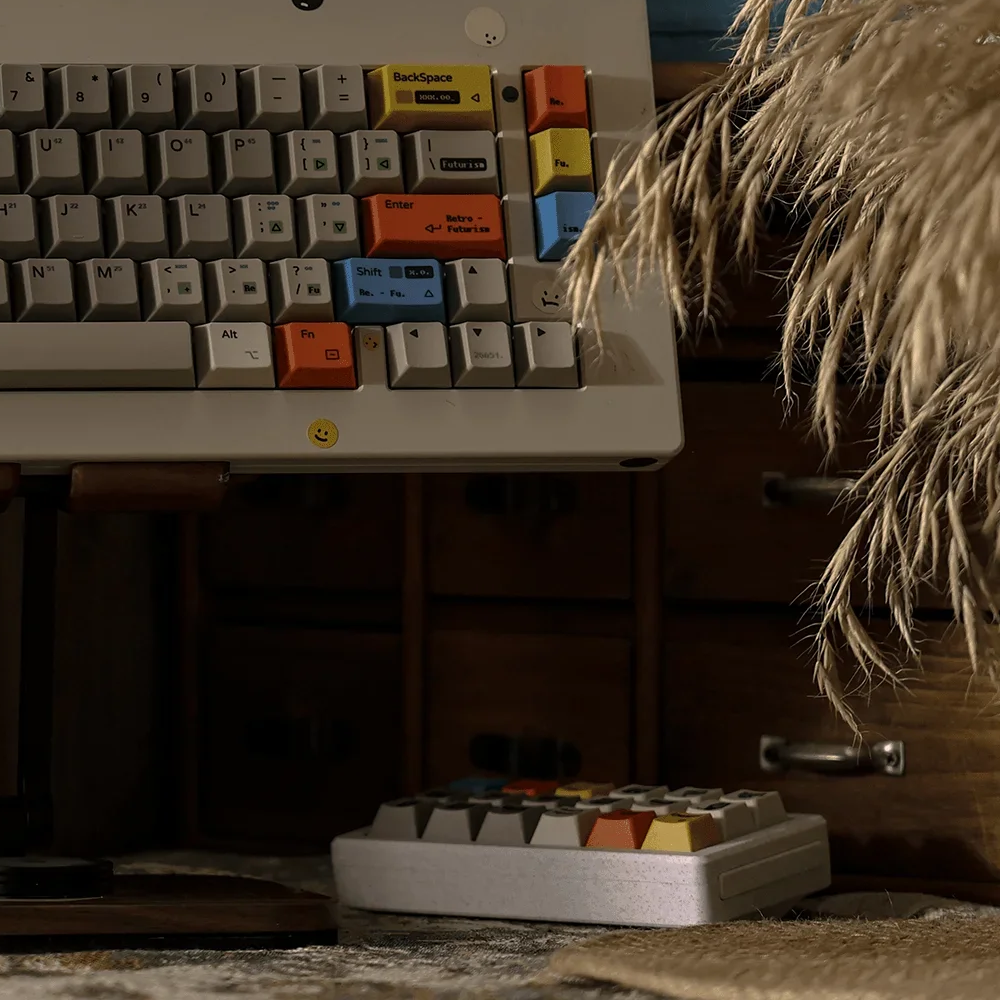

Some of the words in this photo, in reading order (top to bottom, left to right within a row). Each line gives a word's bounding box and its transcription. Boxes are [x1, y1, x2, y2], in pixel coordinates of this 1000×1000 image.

[25, 72, 35, 82] &
[337, 74, 347, 84] +
[393, 72, 453, 83] BackSpace
[10, 91, 18, 101] 7
[76, 92, 84, 102] 8
[141, 93, 149, 102] 9
[204, 92, 212, 102] 0
[40, 139, 52, 151] U
[170, 139, 183, 152] O
[235, 138, 245, 151] P
[442, 159, 486, 169] Futurism
[555, 159, 569, 168] Fu.
[61, 203, 68, 216] J
[126, 203, 138, 216] K
[190, 203, 199, 216] L
[385, 200, 414, 210] Enter
[446, 214, 473, 223] Retro
[447, 225, 490, 233] Futurism
[32, 266, 45, 278] N
[97, 266, 112, 279] M
[164, 266, 171, 274] <
[228, 266, 236, 274] >
[293, 266, 300, 276] ?
[356, 267, 382, 277] Shift
[244, 284, 256, 292] Re
[308, 286, 320, 294] Fu
[359, 289, 374, 297] Re.
[390, 289, 405, 298] Fu.
[221, 330, 238, 339] Alt
[301, 330, 315, 339] Fn
